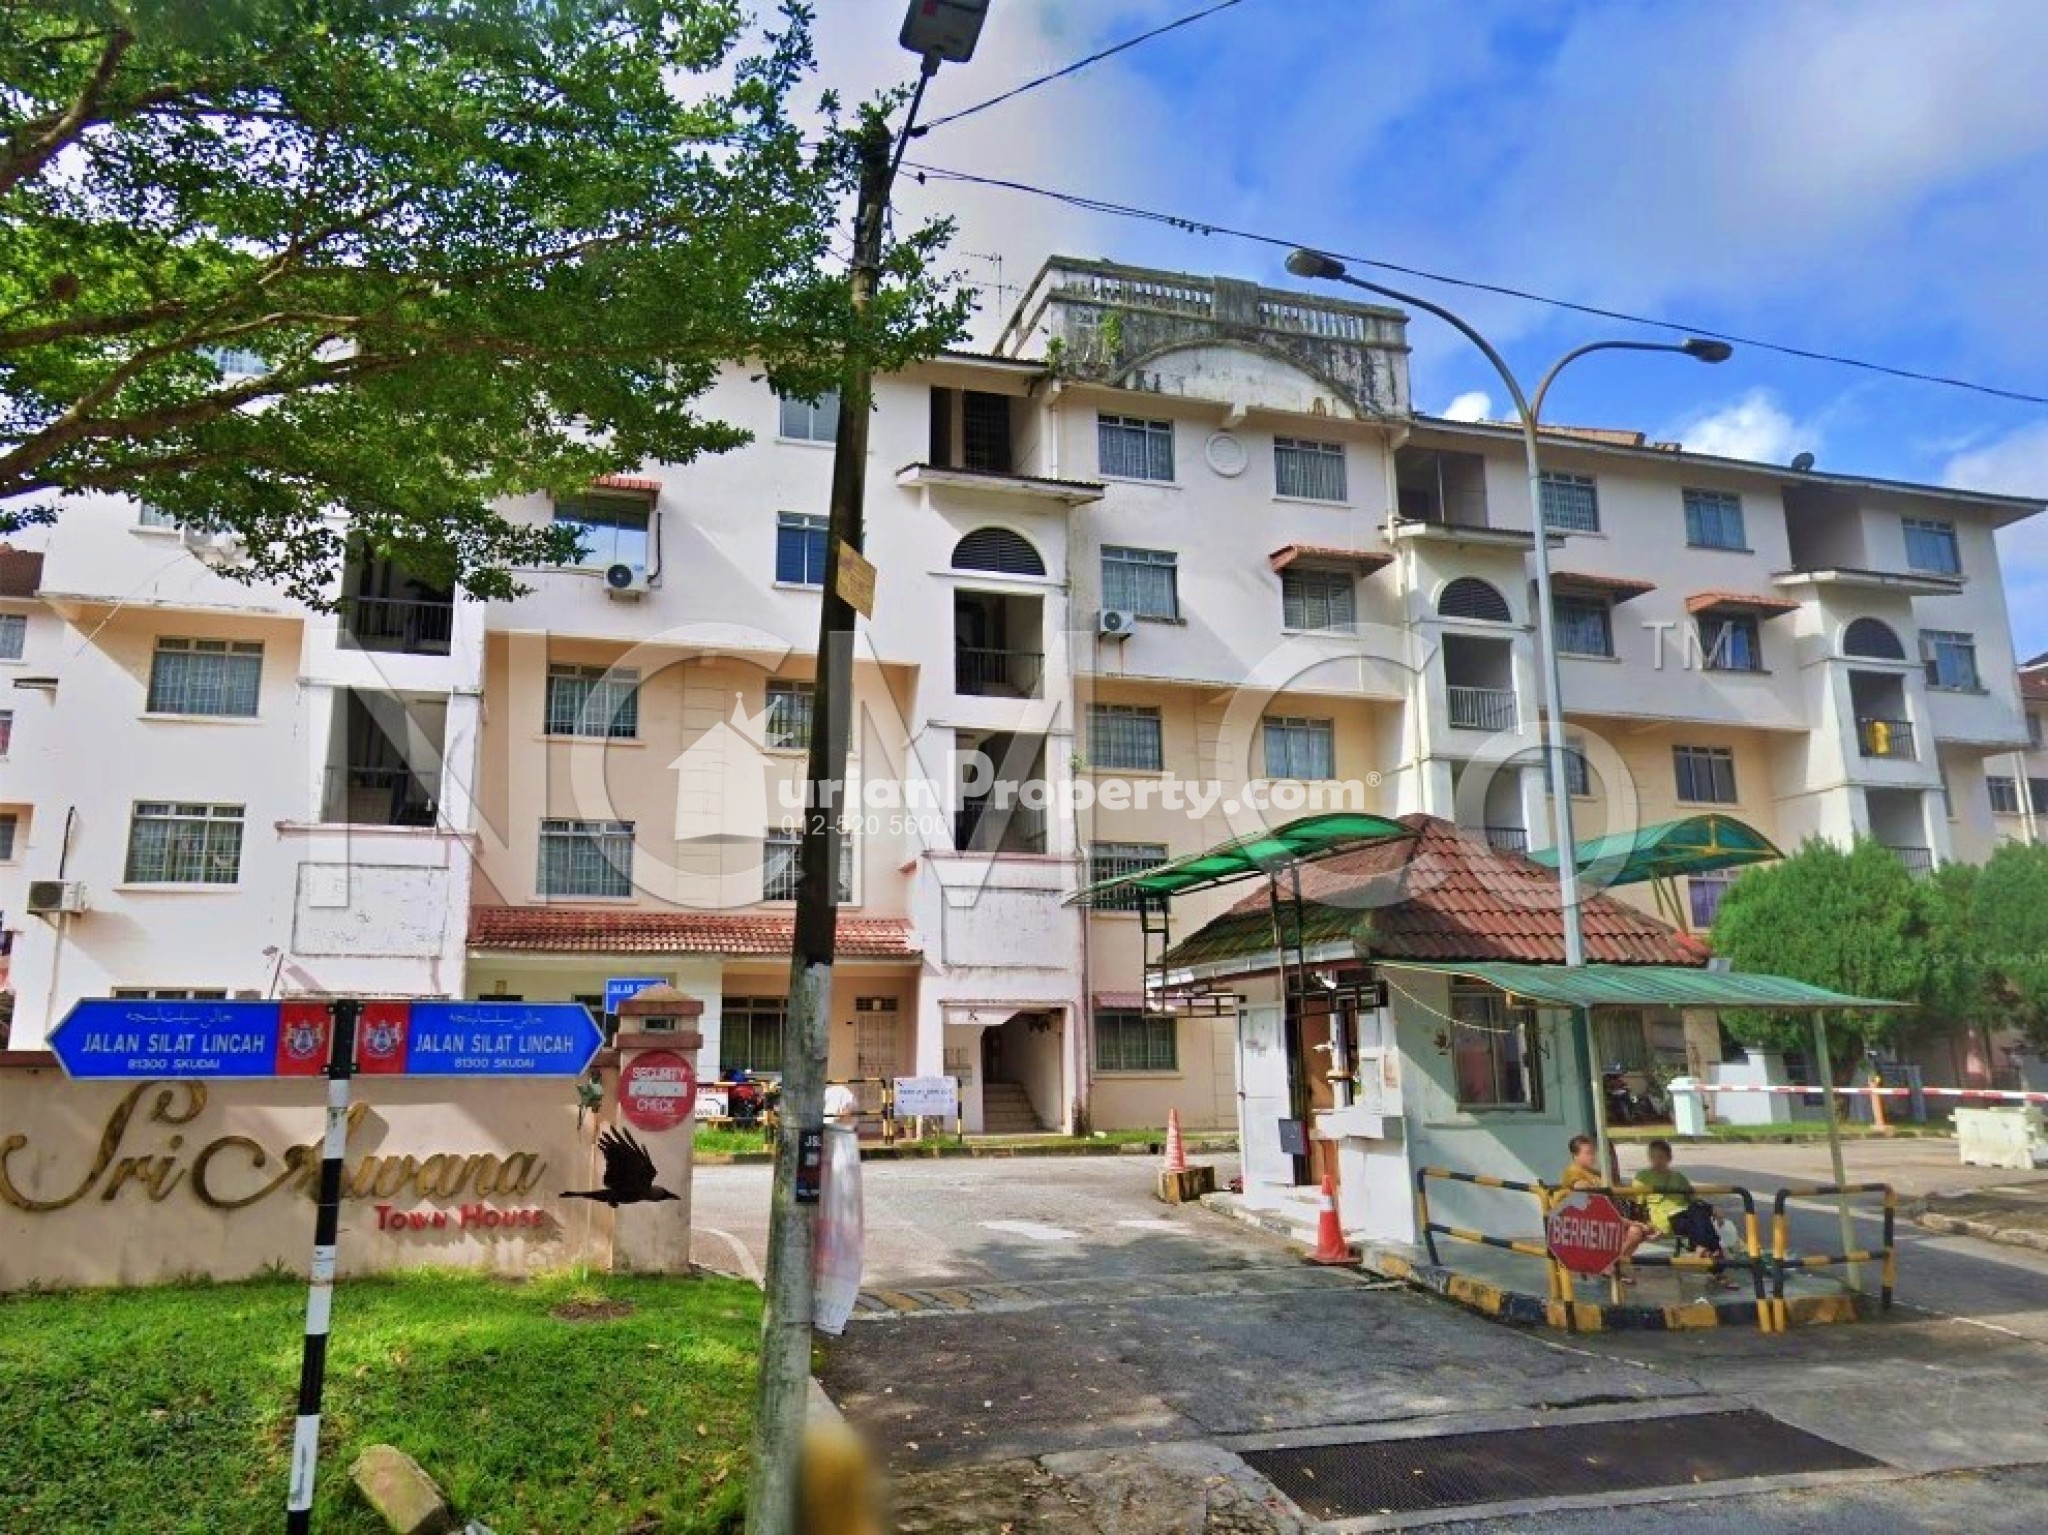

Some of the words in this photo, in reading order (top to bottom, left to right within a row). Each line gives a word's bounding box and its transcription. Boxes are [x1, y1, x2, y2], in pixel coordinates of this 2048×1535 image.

[82, 1033, 140, 1053] JALAN
[147, 1033, 195, 1053] SILAT
[201, 1033, 266, 1053] LINCAH
[415, 1034, 464, 1053] JALAN
[471, 1034, 513, 1053] SILAT
[519, 1034, 574, 1054] LINCAH
[127, 1058, 167, 1069] 81300
[172, 1058, 220, 1069] SKUDAI
[454, 1058, 489, 1068] 81300
[494, 1058, 535, 1068] SKUDAI
[632, 1067, 686, 1081] SECURITY
[636, 1098, 676, 1112] CHECK
[0, 1079, 207, 1212] Sri
[1552, 1215, 1619, 1251] BERHENTI
